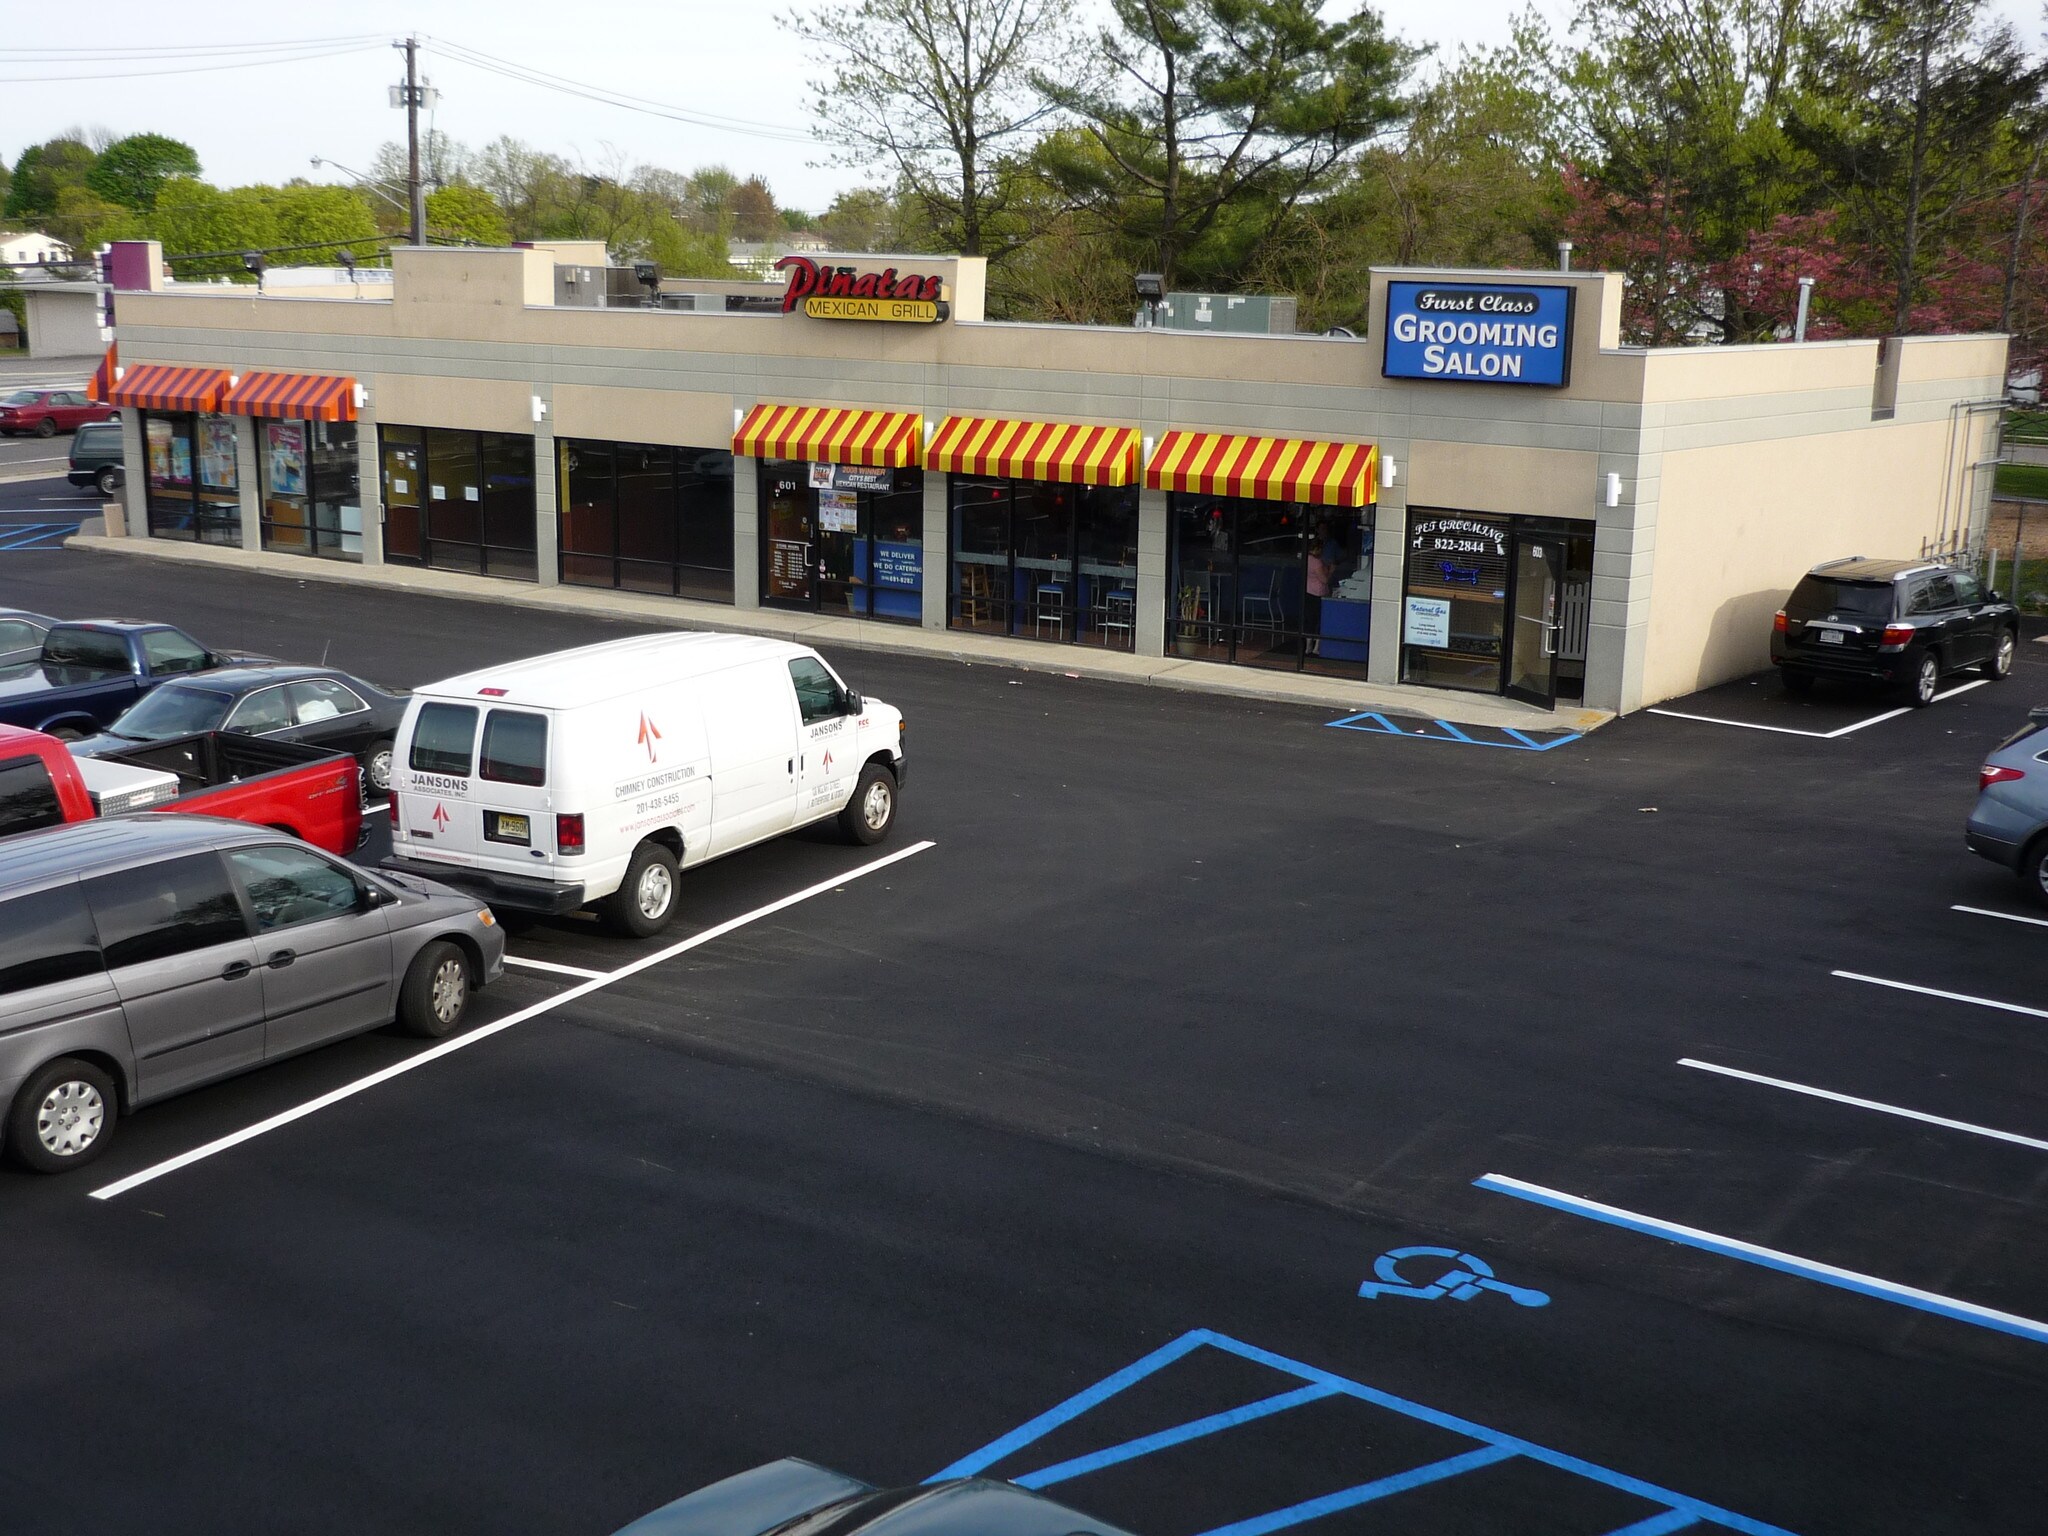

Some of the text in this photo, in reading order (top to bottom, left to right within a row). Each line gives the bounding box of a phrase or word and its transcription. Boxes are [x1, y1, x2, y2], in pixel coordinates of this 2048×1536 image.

[774, 256, 942, 313] Piñatas
[809, 301, 934, 319] MEXICAN GRILL
[1420, 293, 1534, 313] Furst Class
[1393, 314, 1558, 348] GROOMING
[1423, 345, 1521, 378] SALON
[859, 467, 886, 476] WINNER
[779, 480, 796, 490] 601
[836, 481, 890, 491] MEXICAN RESTAURANT
[1415, 519, 1504, 543] PET GROOMING
[1434, 538, 1484, 553] 822-2844
[1532, 545, 1543, 559] 603
[891, 552, 915, 560] DELIVER
[895, 565, 923, 573] CATERING
[1410, 603, 1434, 613] Natural
[1435, 606, 1446, 615] Gas
[810, 720, 843, 738] JANSONS
[411, 773, 469, 791] JANSONS
[615, 765, 696, 799] CHIMNEY CONSTRUCTION
[636, 792, 680, 815] 201-438-5455
